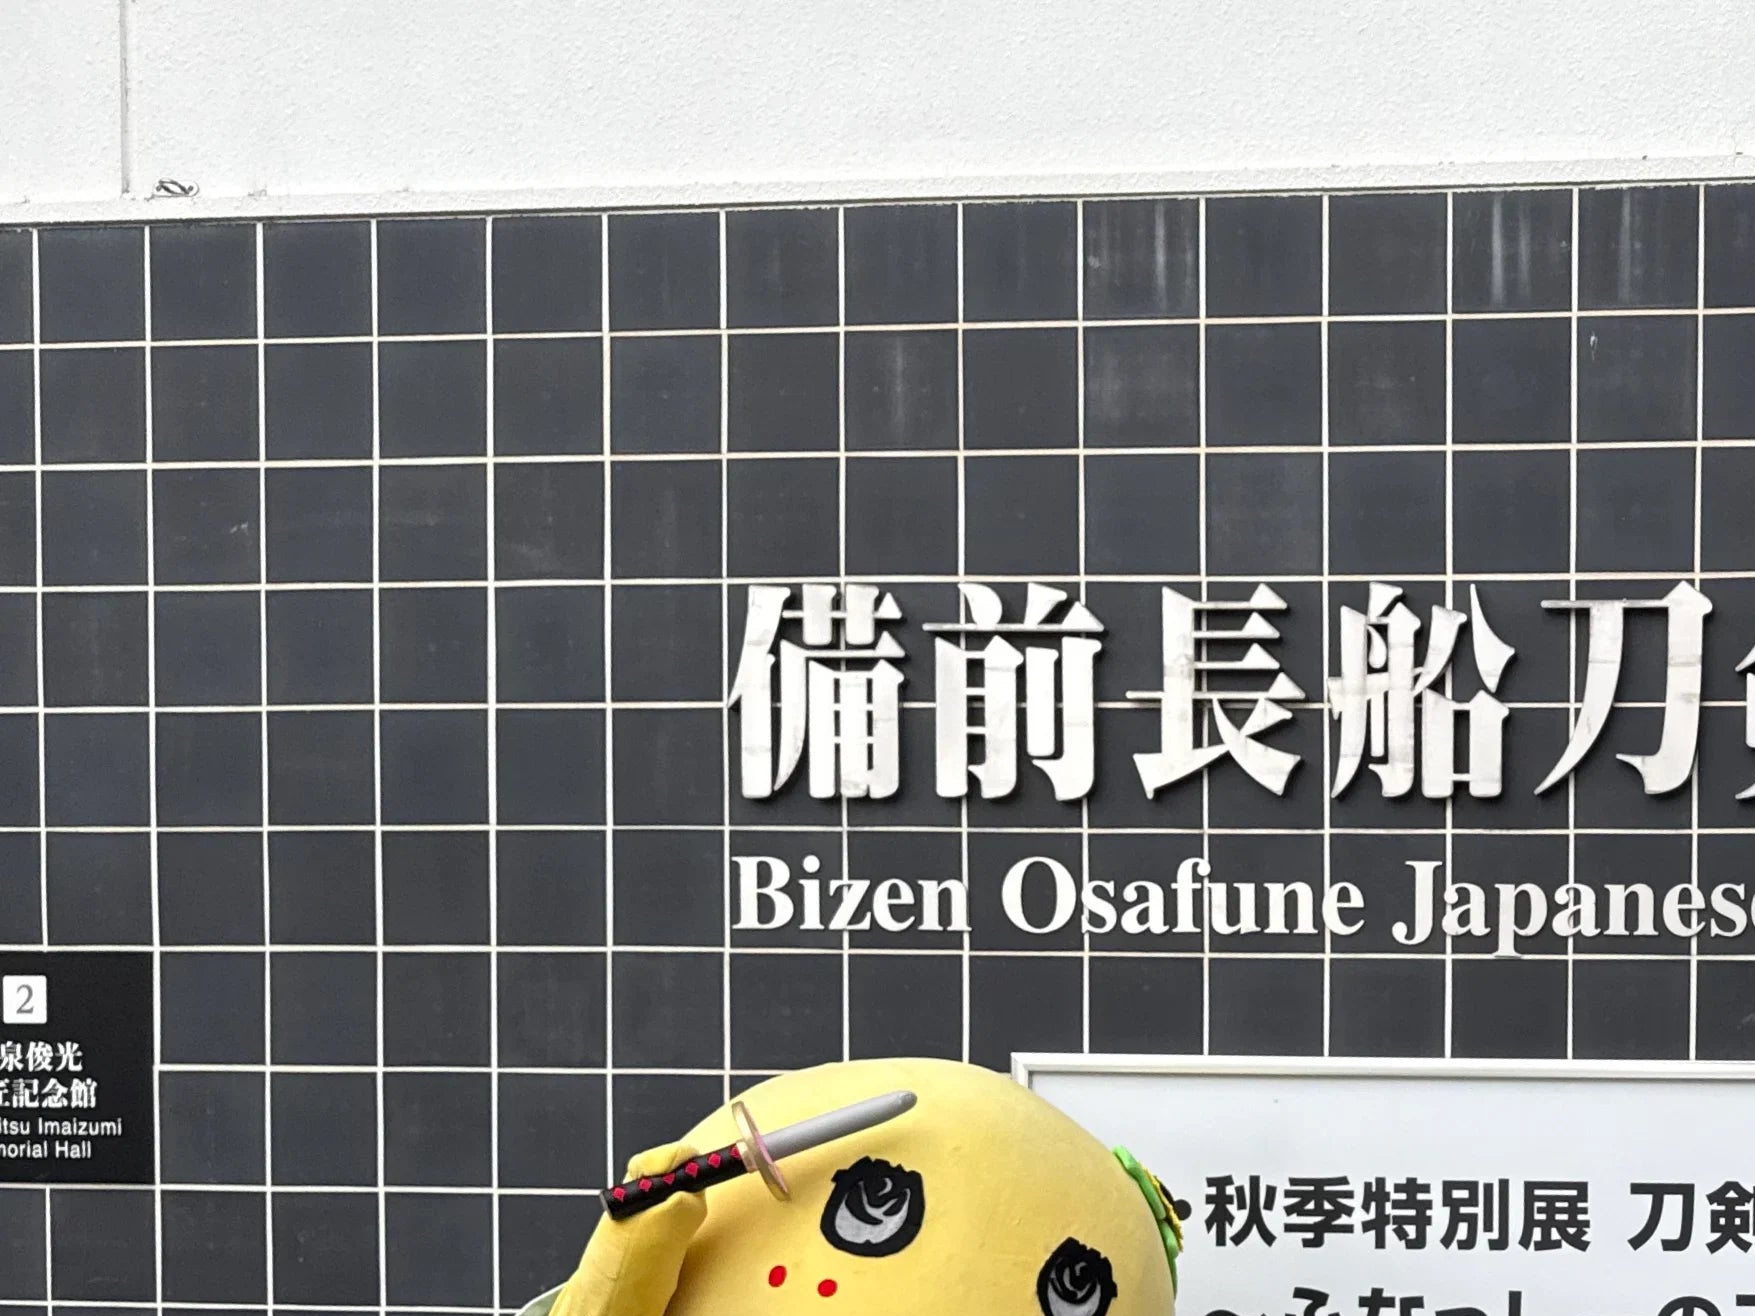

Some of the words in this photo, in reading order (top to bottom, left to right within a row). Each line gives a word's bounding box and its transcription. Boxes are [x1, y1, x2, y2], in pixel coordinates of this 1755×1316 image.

[731, 855, 972, 932] Bizen
[1002, 856, 1366, 935] Osafune
[15, 983, 35, 1015] 2
[38, 1117, 122, 1136] Imaizumi
[55, 1140, 92, 1159] Hall
[1204, 1174, 1592, 1253] 秋季特別展
